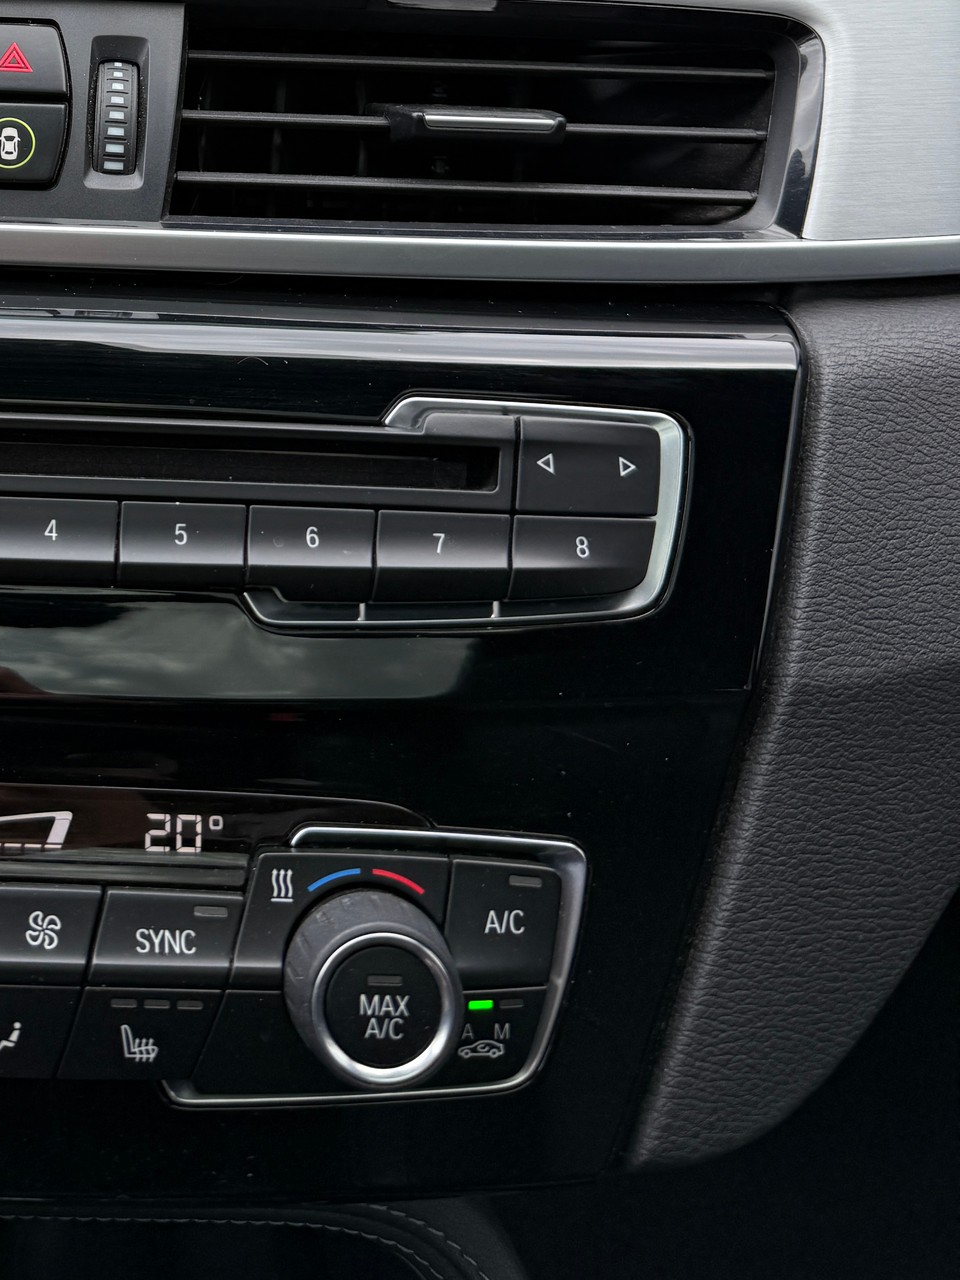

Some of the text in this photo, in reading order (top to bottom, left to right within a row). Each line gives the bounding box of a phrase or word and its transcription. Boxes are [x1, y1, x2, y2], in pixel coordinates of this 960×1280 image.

[44, 520, 58, 541] 4
[174, 524, 188, 545] 5
[306, 527, 319, 549] 6
[433, 533, 445, 554] 7
[576, 536, 590, 558] 8
[485, 911, 525, 934] A/C
[135, 930, 196, 955] SYNC
[360, 995, 409, 1017] MAX
[365, 1018, 404, 1040] A/C
[462, 1024, 473, 1039] A
[495, 1024, 510, 1039] M
